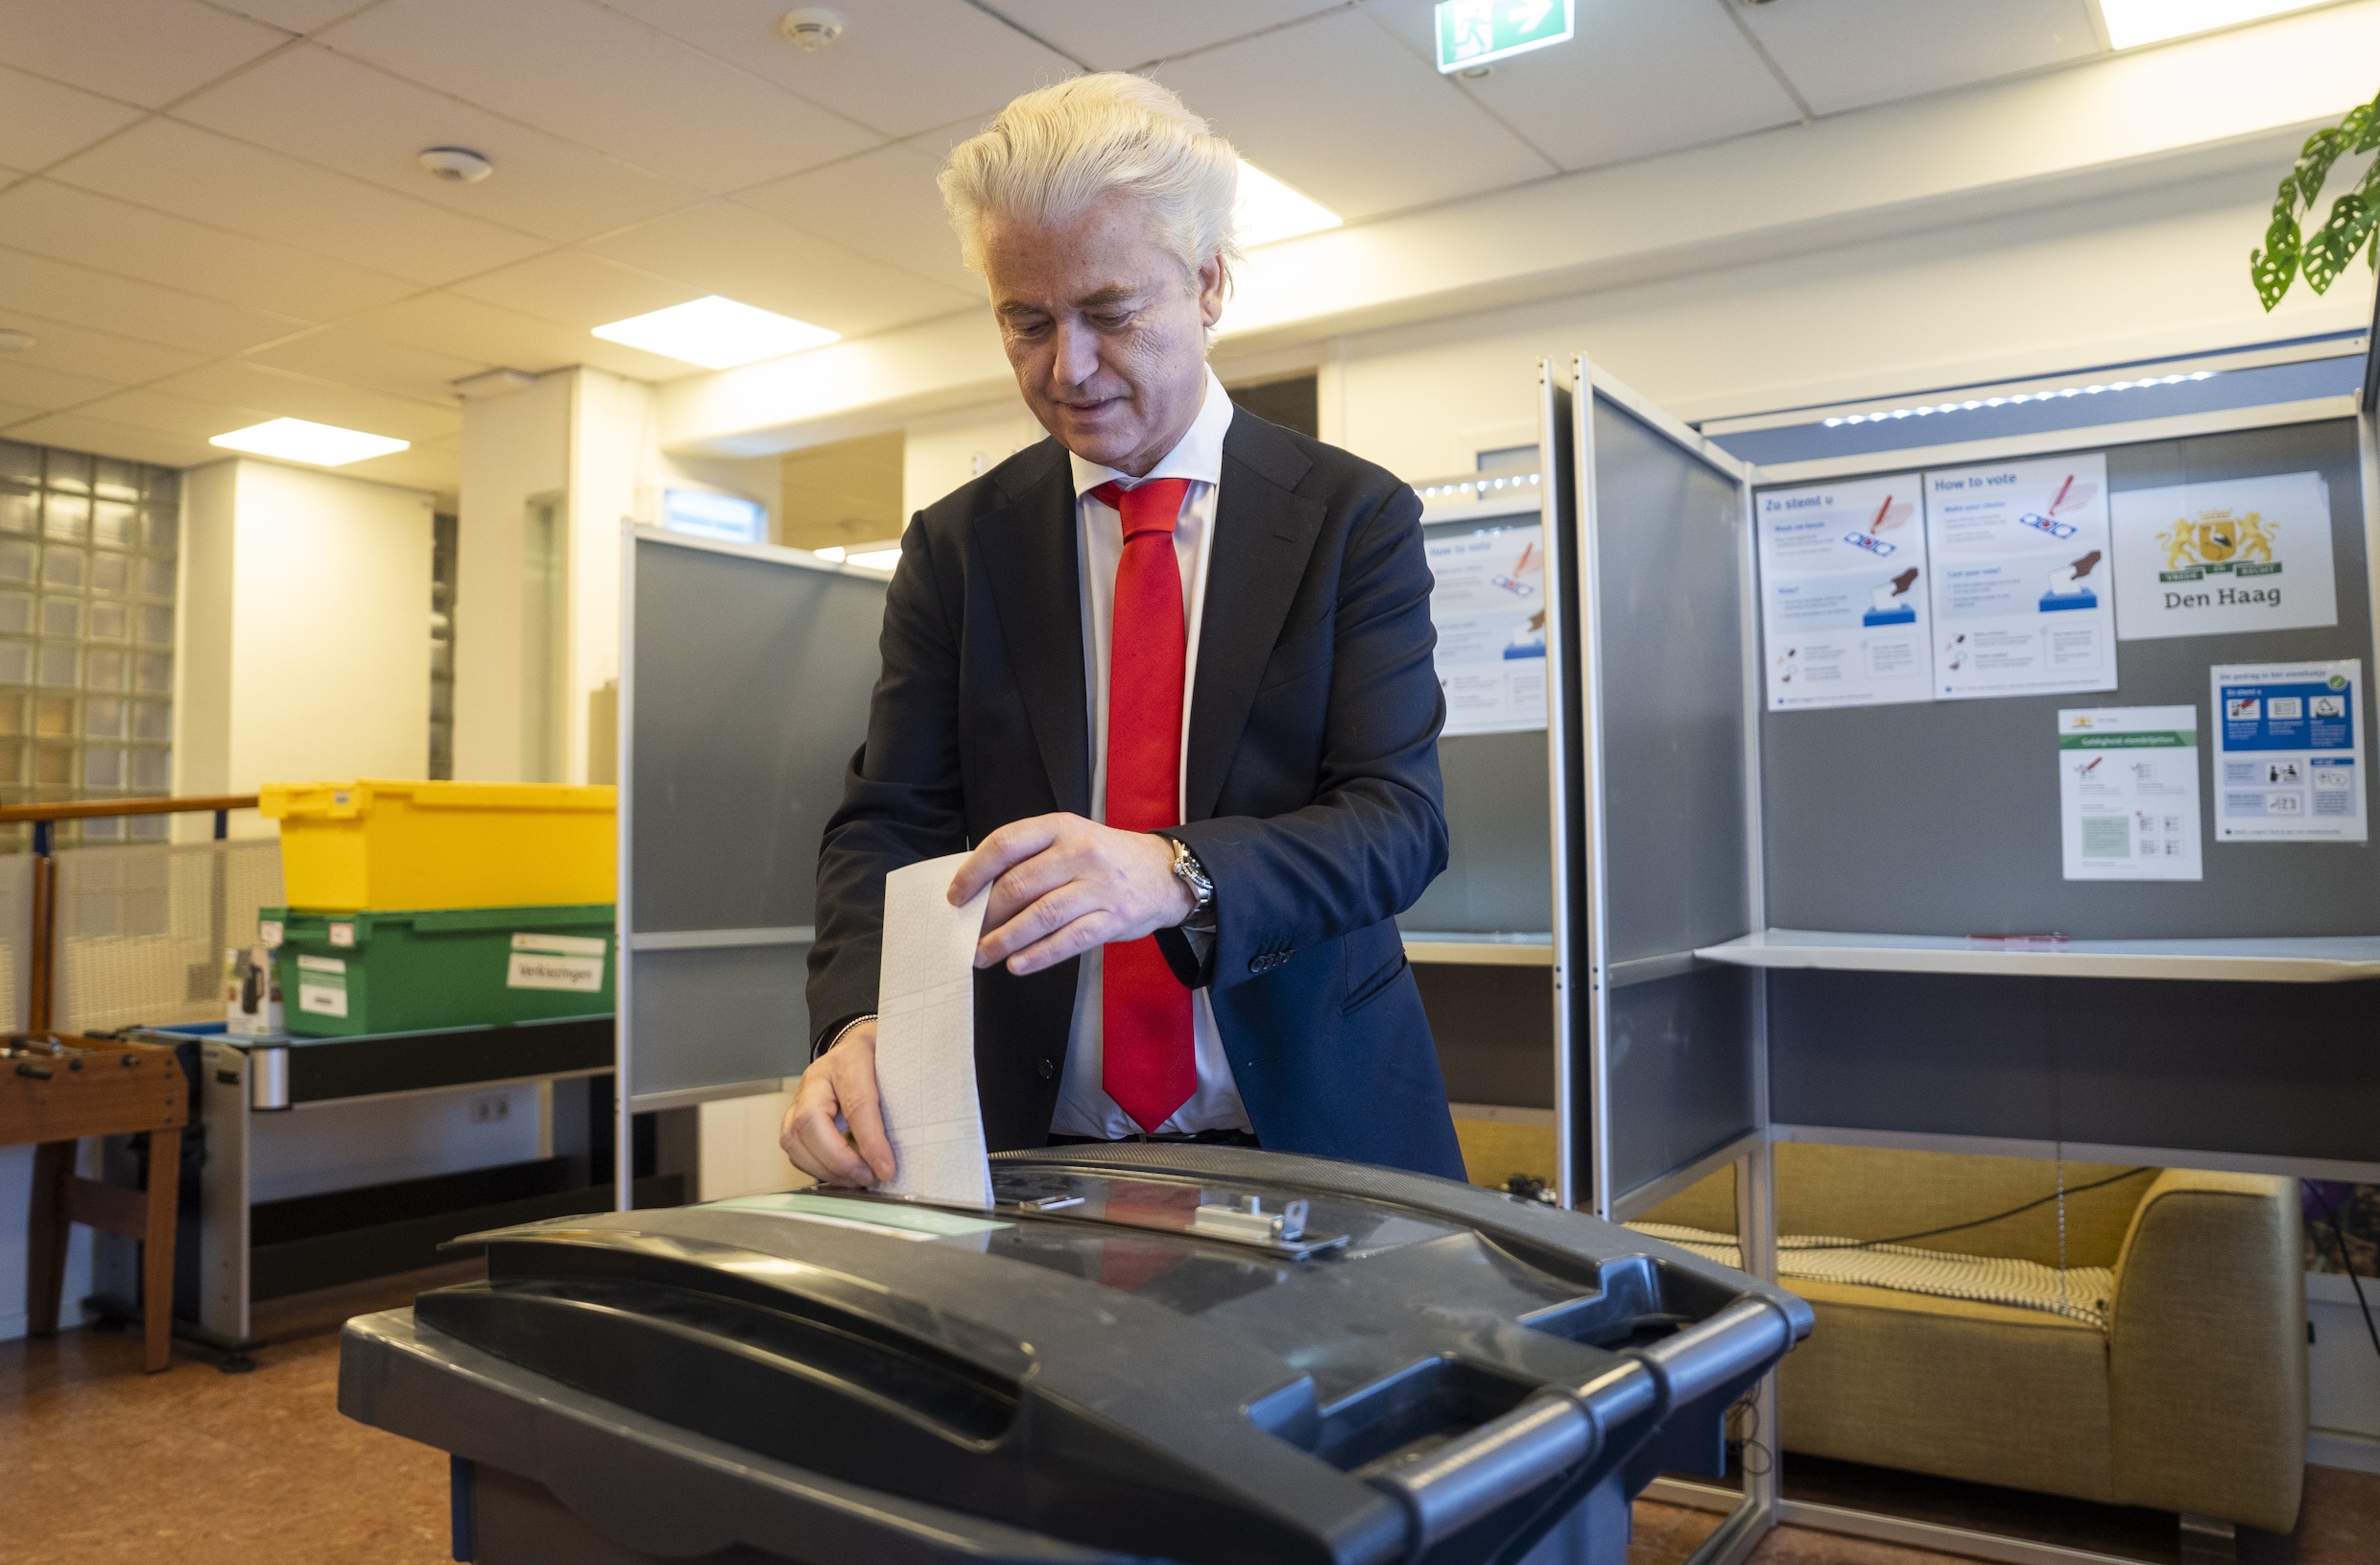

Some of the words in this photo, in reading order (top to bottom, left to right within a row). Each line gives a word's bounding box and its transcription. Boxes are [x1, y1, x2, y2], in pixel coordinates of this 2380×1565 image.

[1935, 479, 1964, 491] How
[1968, 476, 1983, 488] to
[1986, 473, 2017, 486] vote
[1766, 498, 1781, 511] Zo
[1785, 495, 1821, 510] stemt
[1825, 496, 1834, 505] u
[2165, 591, 2210, 609] Den
[2218, 587, 2281, 607] Haag
[520, 962, 593, 984] Verkiezingen
